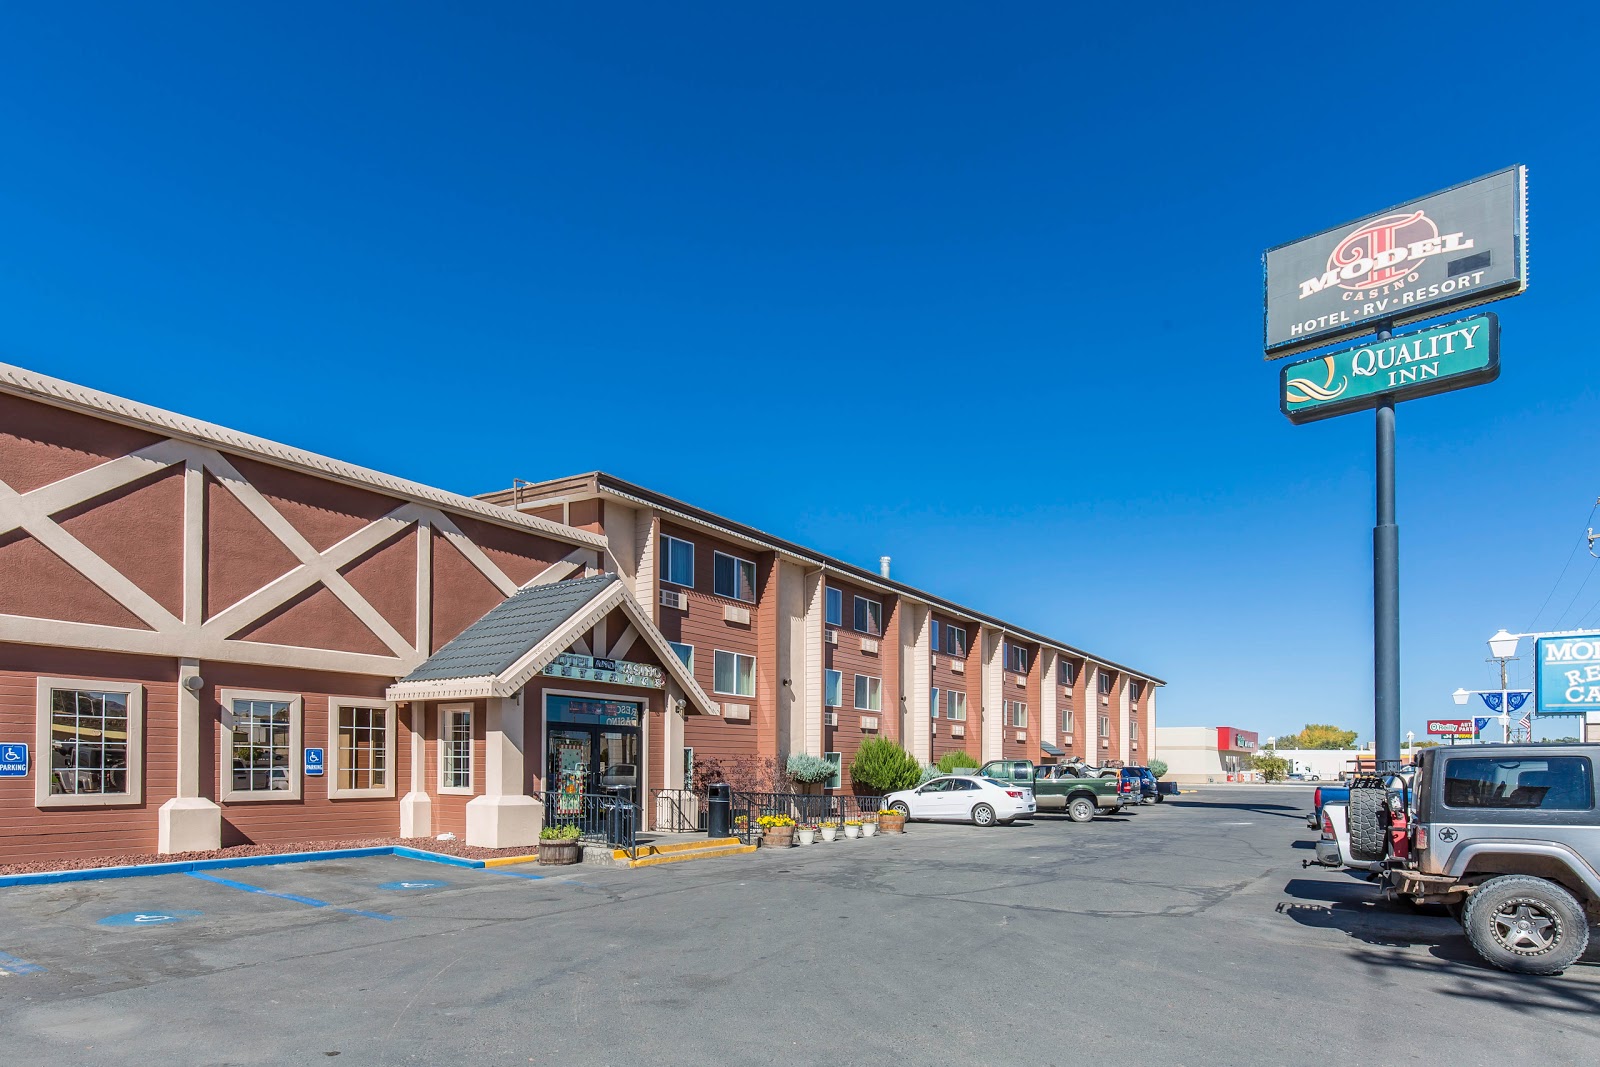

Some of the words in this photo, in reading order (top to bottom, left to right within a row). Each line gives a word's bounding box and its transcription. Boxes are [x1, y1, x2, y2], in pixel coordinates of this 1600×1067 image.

[1299, 232, 1474, 299] MODEL
[1342, 272, 1419, 301] CASINO
[1291, 311, 1350, 335] HOTEL
[1363, 299, 1388, 316] RV
[1402, 271, 1485, 305] RESORT
[1352, 325, 1480, 377] QUALITY
[1388, 362, 1439, 386] INN
[595, 659, 614, 670] AND
[615, 661, 661, 678] CASINO
[0, 763, 26, 771] PARKING
